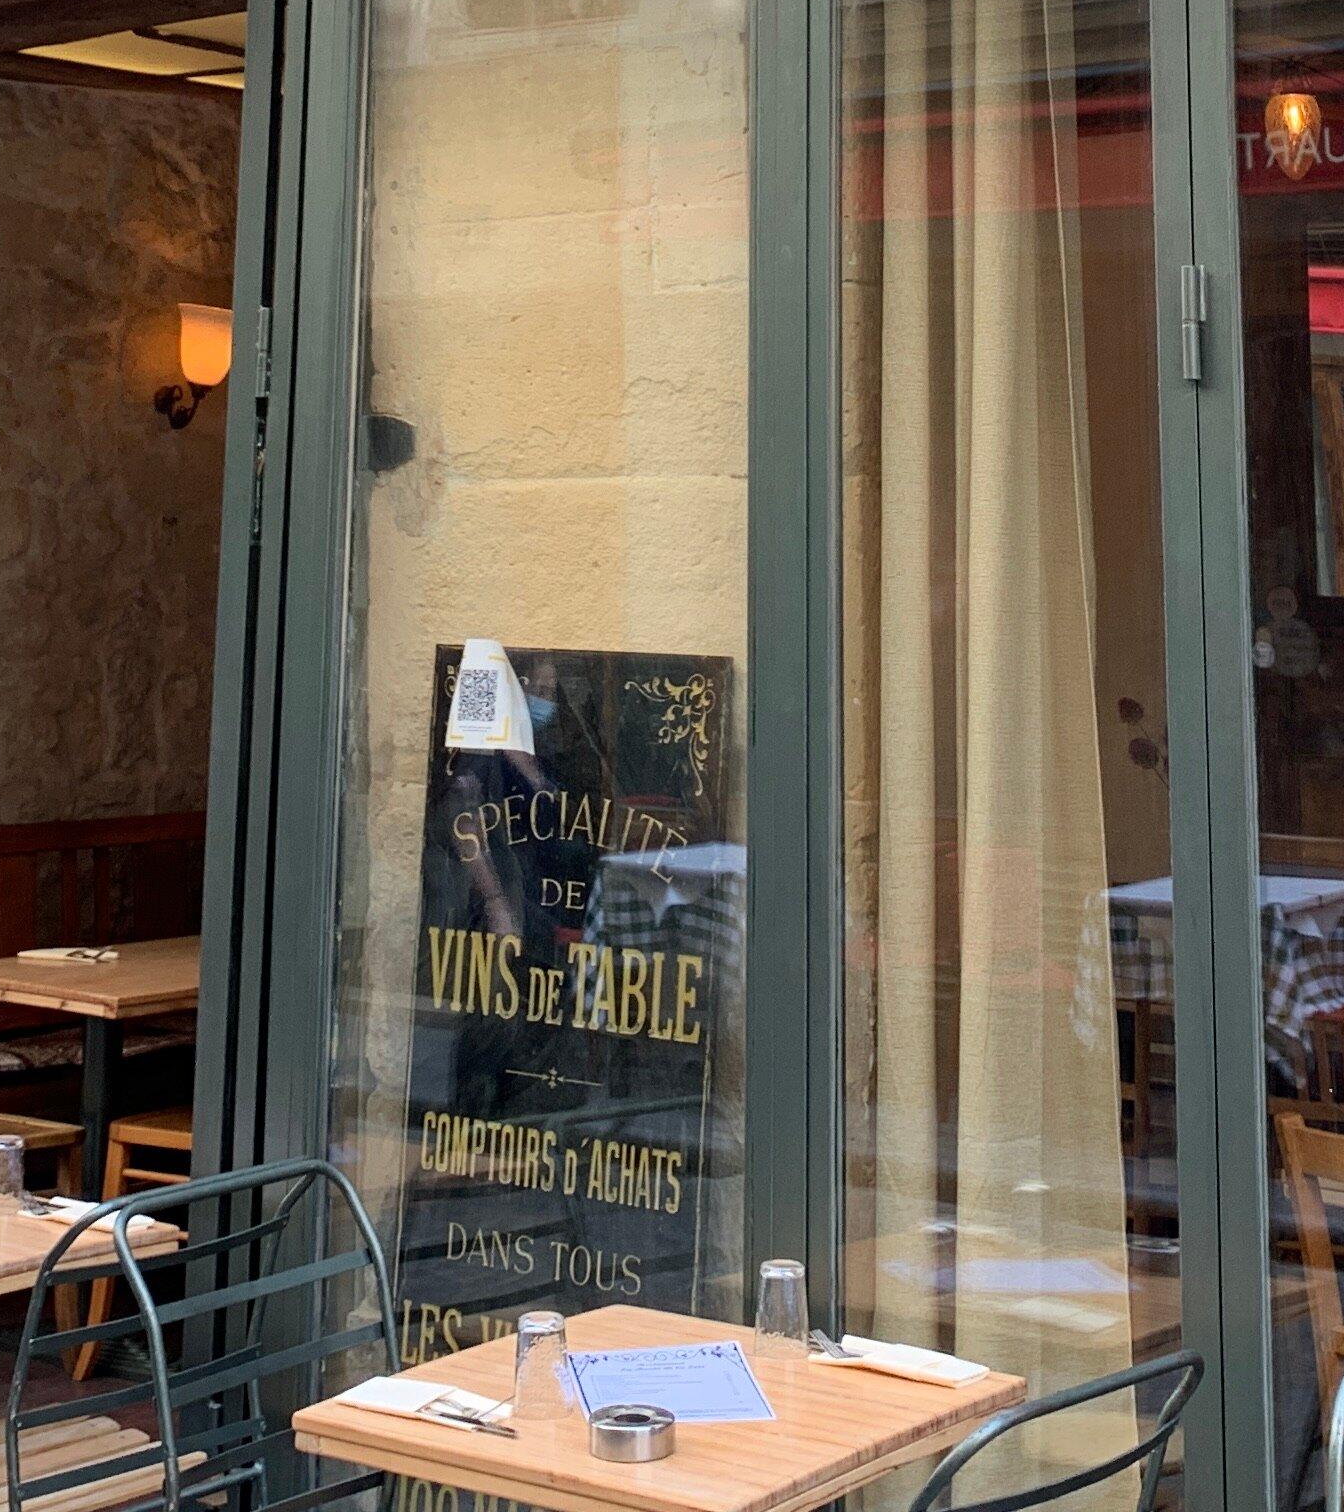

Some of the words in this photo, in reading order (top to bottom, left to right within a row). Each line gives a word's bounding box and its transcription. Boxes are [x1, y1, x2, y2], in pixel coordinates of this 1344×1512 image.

[453, 787, 688, 885] SPÉCIALITÉ
[540, 878, 586, 910] DE
[429, 925, 522, 1020] VINS
[527, 966, 564, 1026] DE
[568, 942, 702, 1044] TABLE
[420, 1110, 556, 1192] COMPTOIRS
[446, 1221, 536, 1275] DANS
[551, 1240, 643, 1296] TOUS
